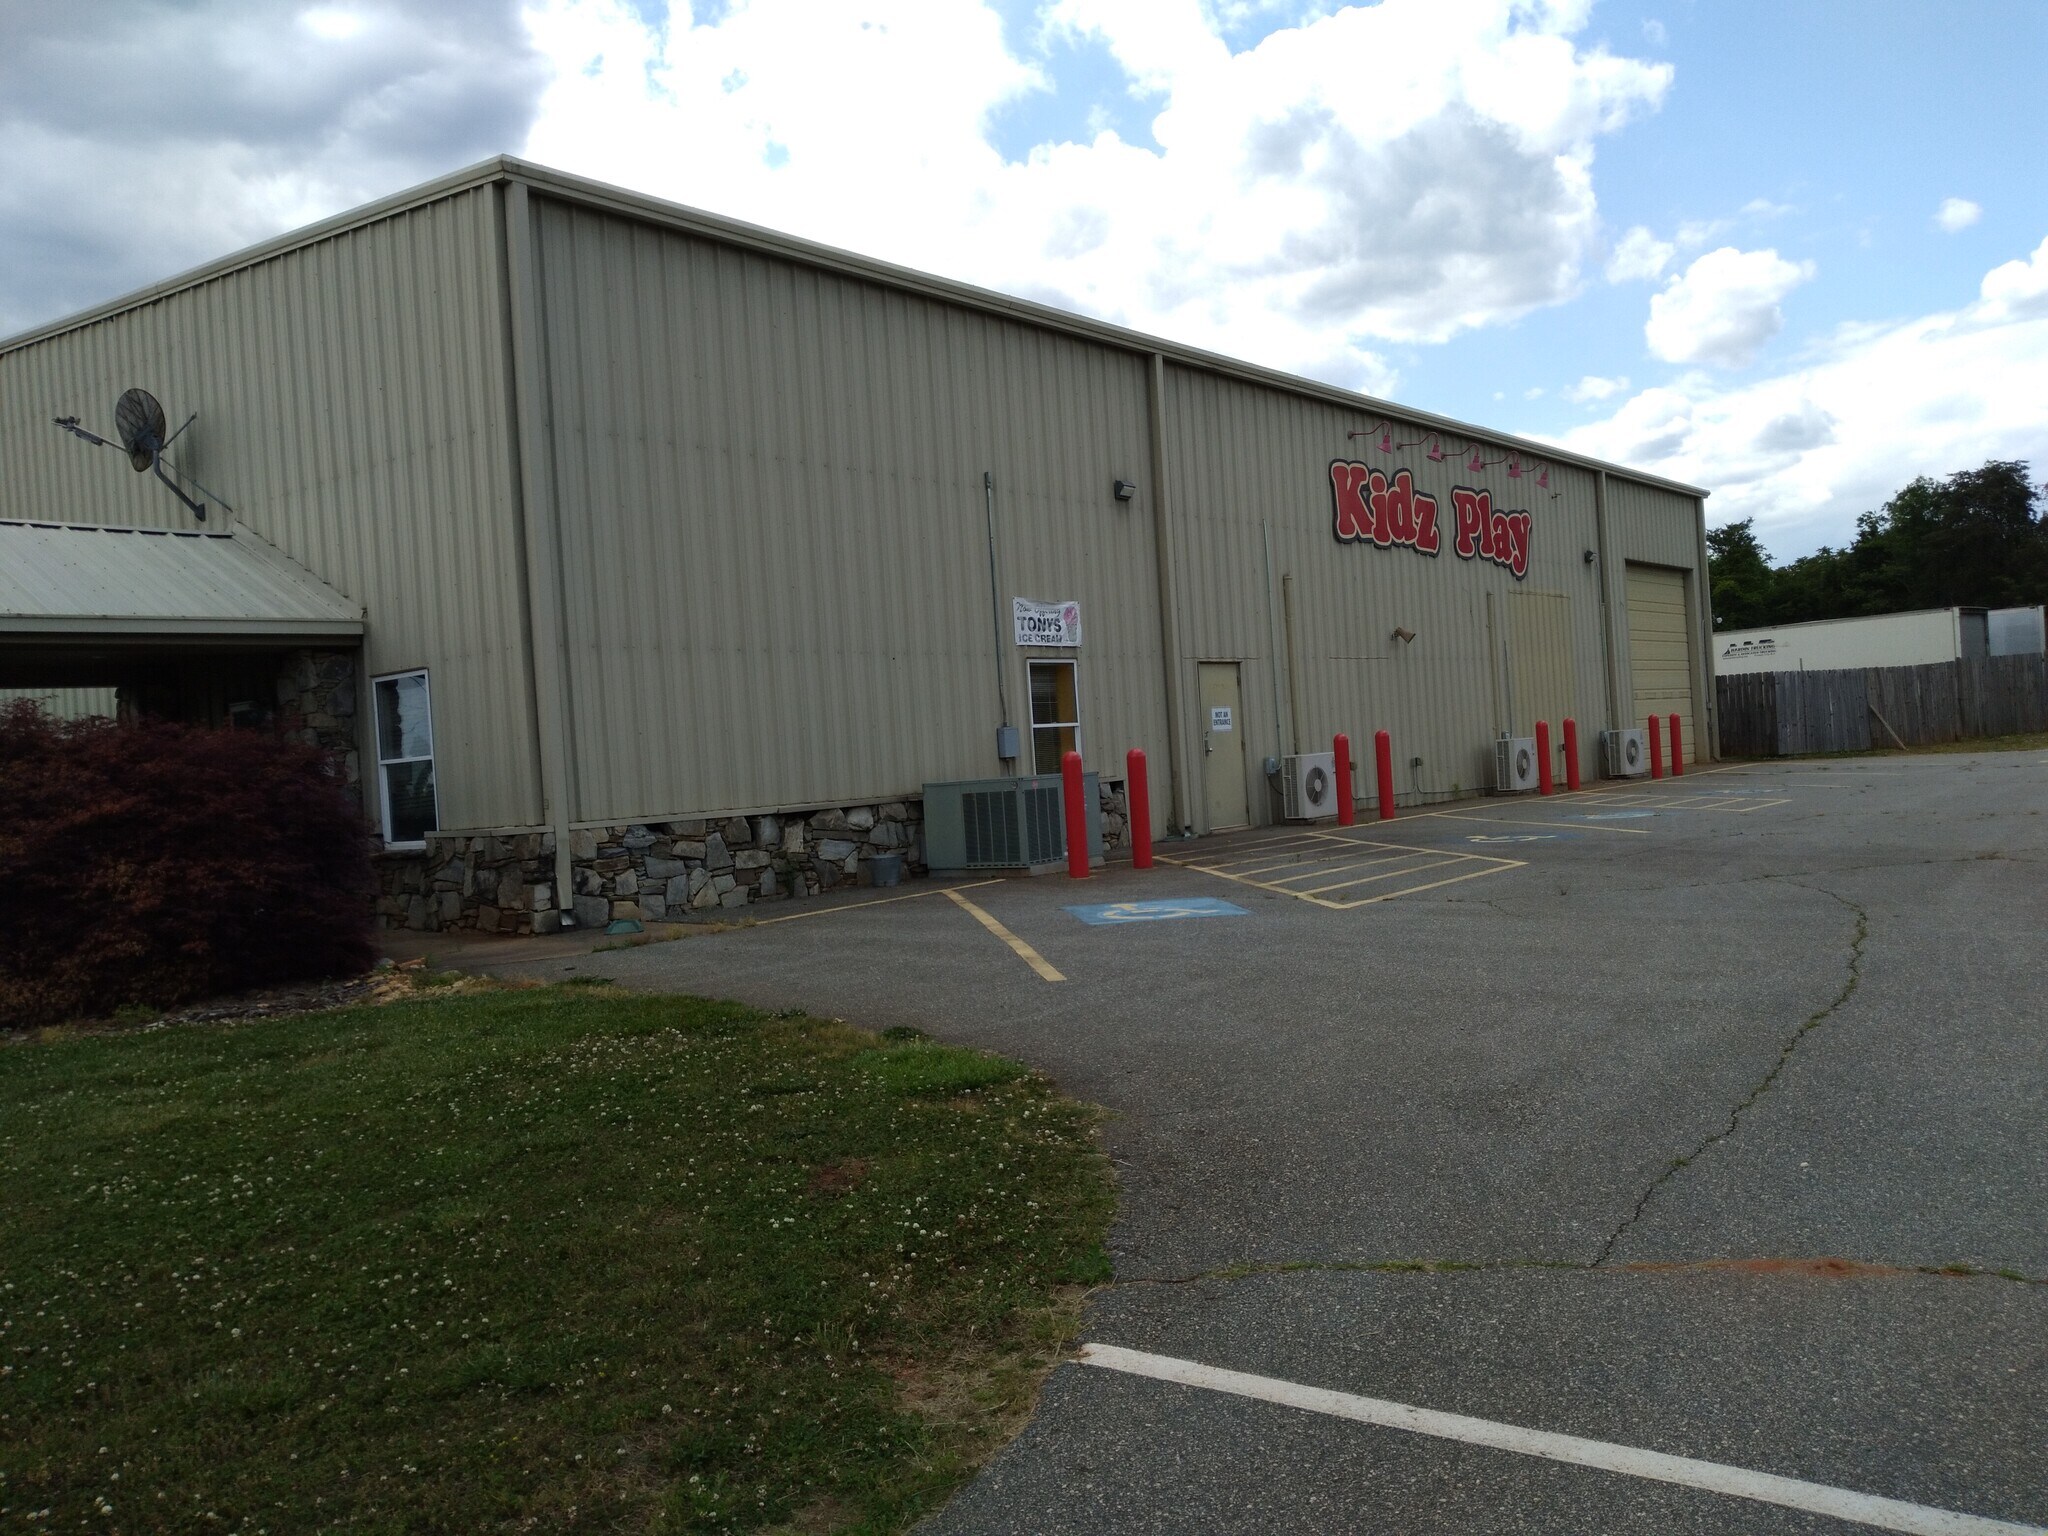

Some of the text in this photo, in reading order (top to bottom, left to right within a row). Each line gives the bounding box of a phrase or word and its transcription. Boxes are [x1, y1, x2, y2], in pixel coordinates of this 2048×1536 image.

[1329, 459, 1532, 581] Kidz Play
[1016, 602, 1032, 613] Now
[1018, 634, 1062, 643] ICE CREAM
[1213, 718, 1231, 726] ENTRANCE
